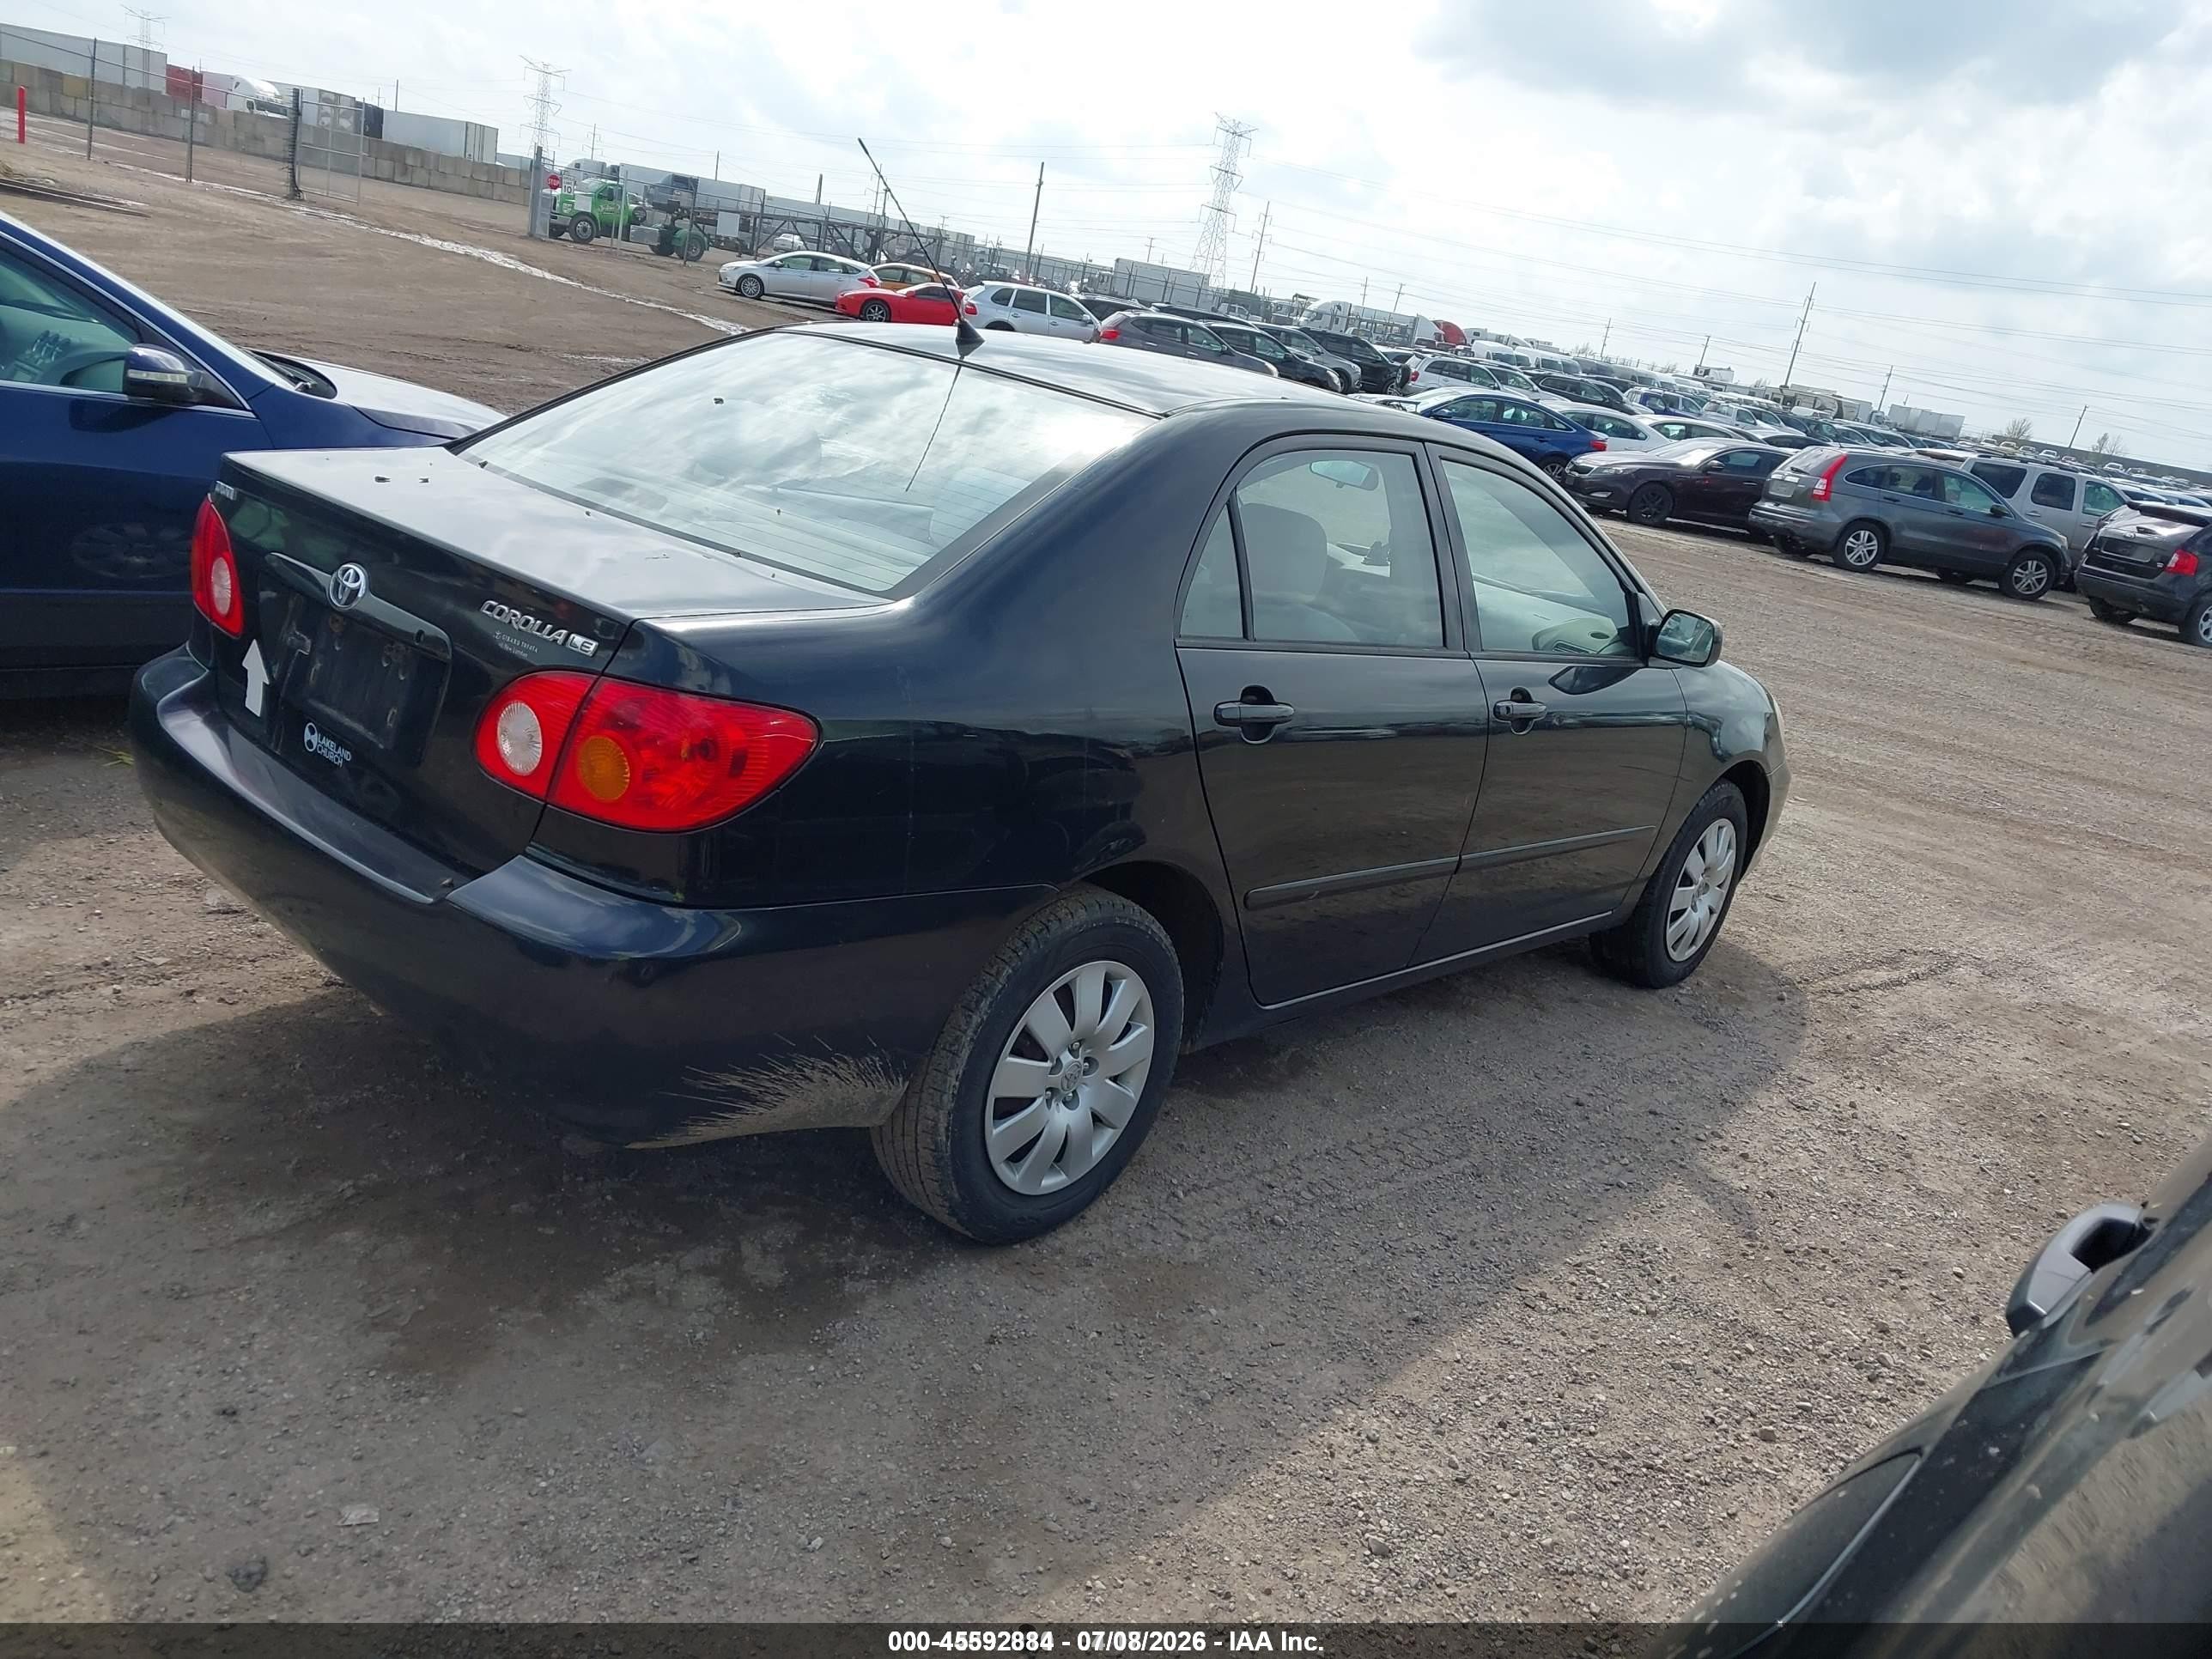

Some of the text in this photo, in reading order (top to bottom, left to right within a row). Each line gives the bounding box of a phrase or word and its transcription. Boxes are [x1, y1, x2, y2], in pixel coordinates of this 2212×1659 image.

[548, 178, 560, 186] STOP
[563, 185, 573, 194] 10
[480, 600, 595, 654] COROLLA LE
[317, 744, 343, 769] CHURCH
[318, 732, 351, 762] LAKELAND
